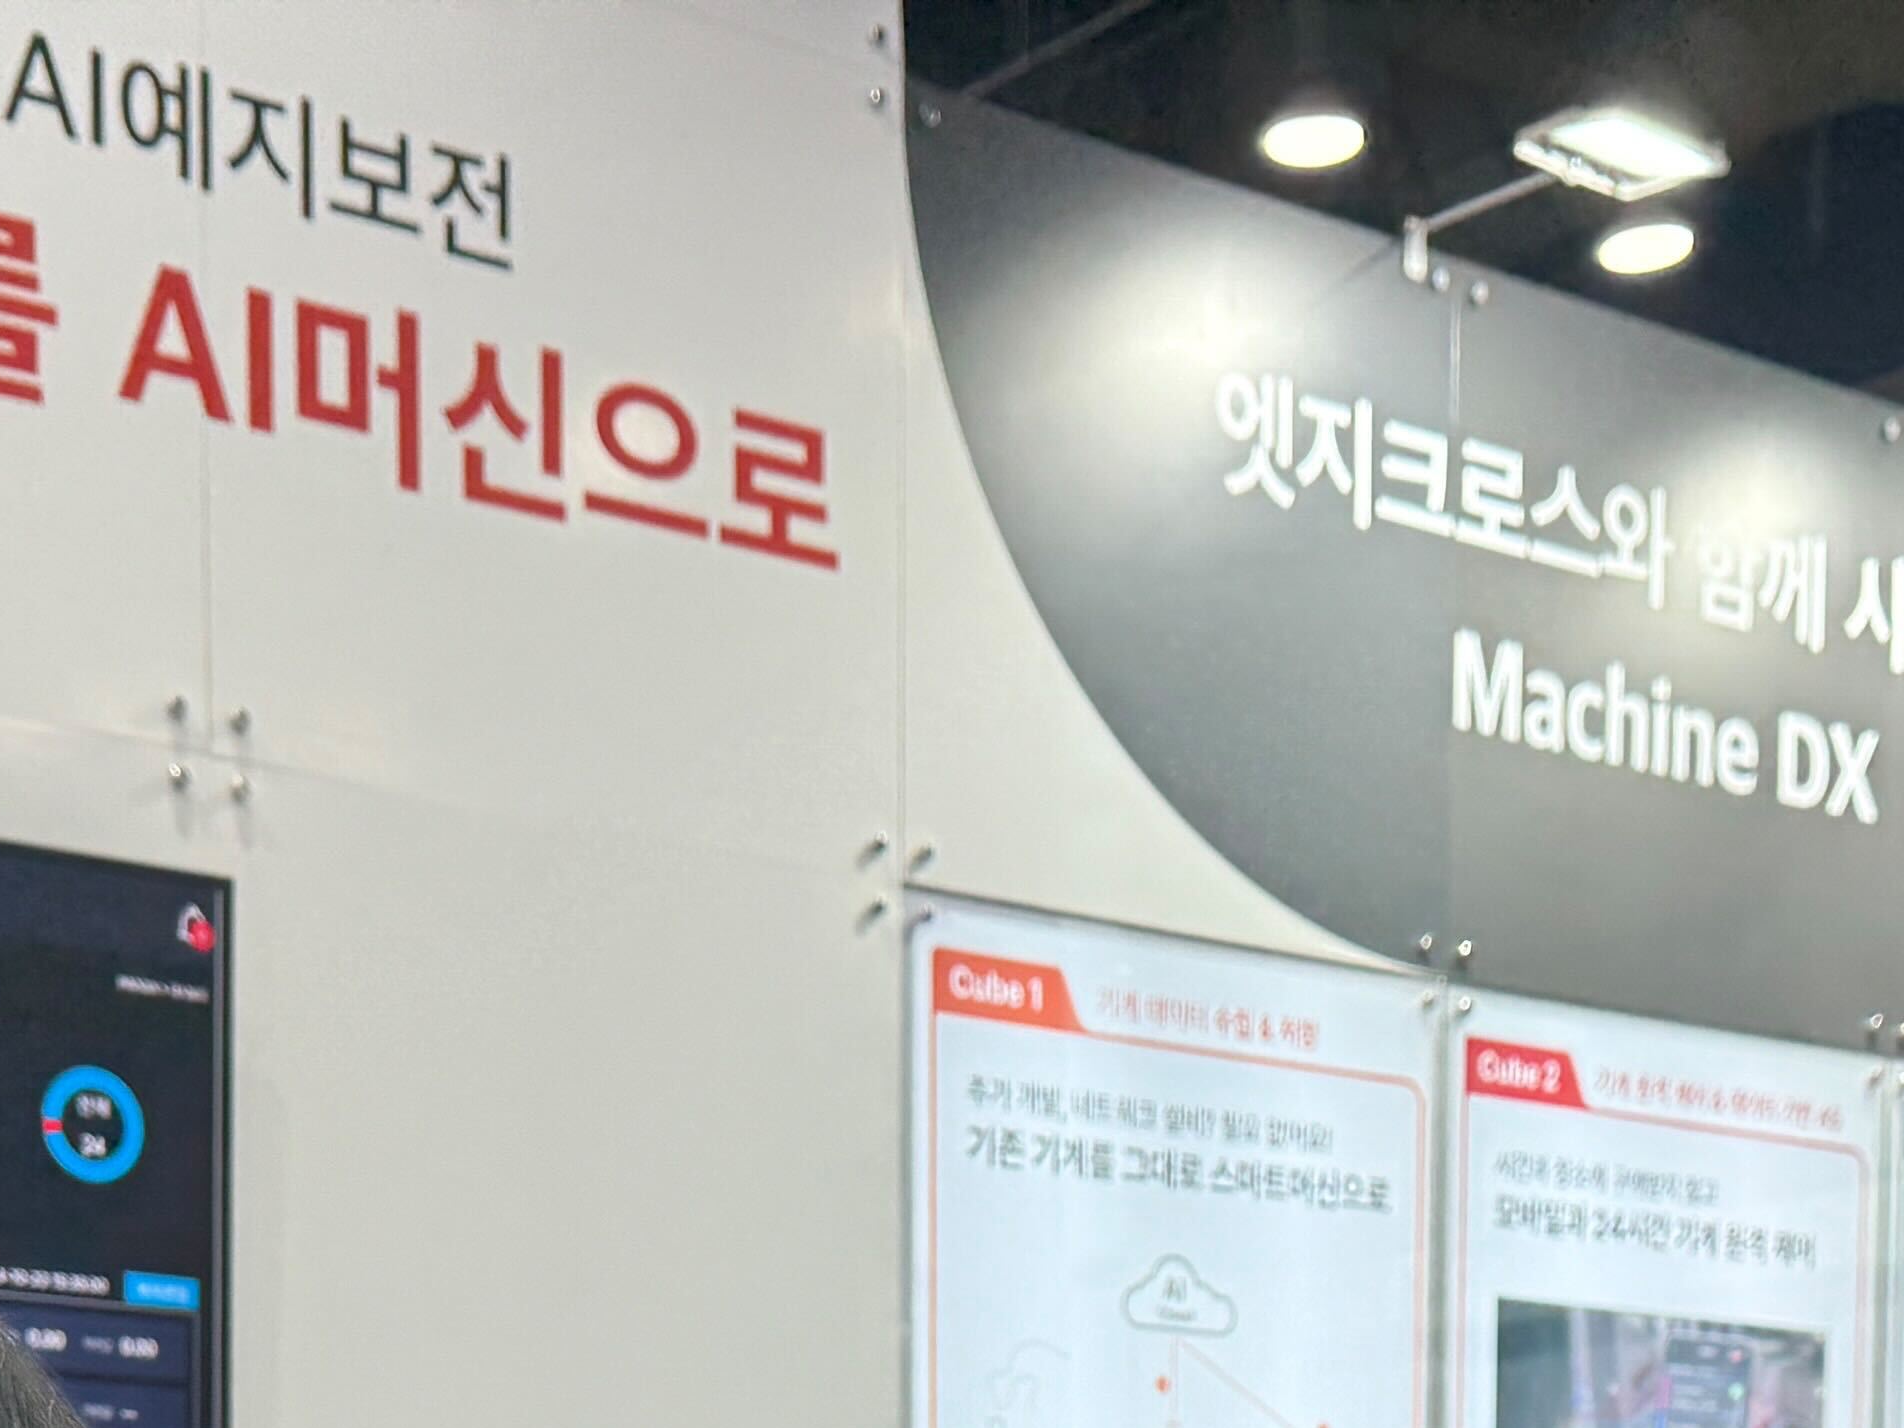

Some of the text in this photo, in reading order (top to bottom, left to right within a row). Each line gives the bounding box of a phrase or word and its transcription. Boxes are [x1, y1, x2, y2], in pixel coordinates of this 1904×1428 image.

[116, 260, 841, 572] AI머신으로
[1212, 370, 1672, 611] 엣지크로스와
[1698, 528, 1827, 654] 함께
[1451, 628, 1881, 826] Machine DX
[948, 962, 1044, 1013] Cube 1
[1477, 1050, 1562, 1093] Cube 2
[965, 1122, 1394, 1214] 기존 기계를 그대로 스마트머신으로
